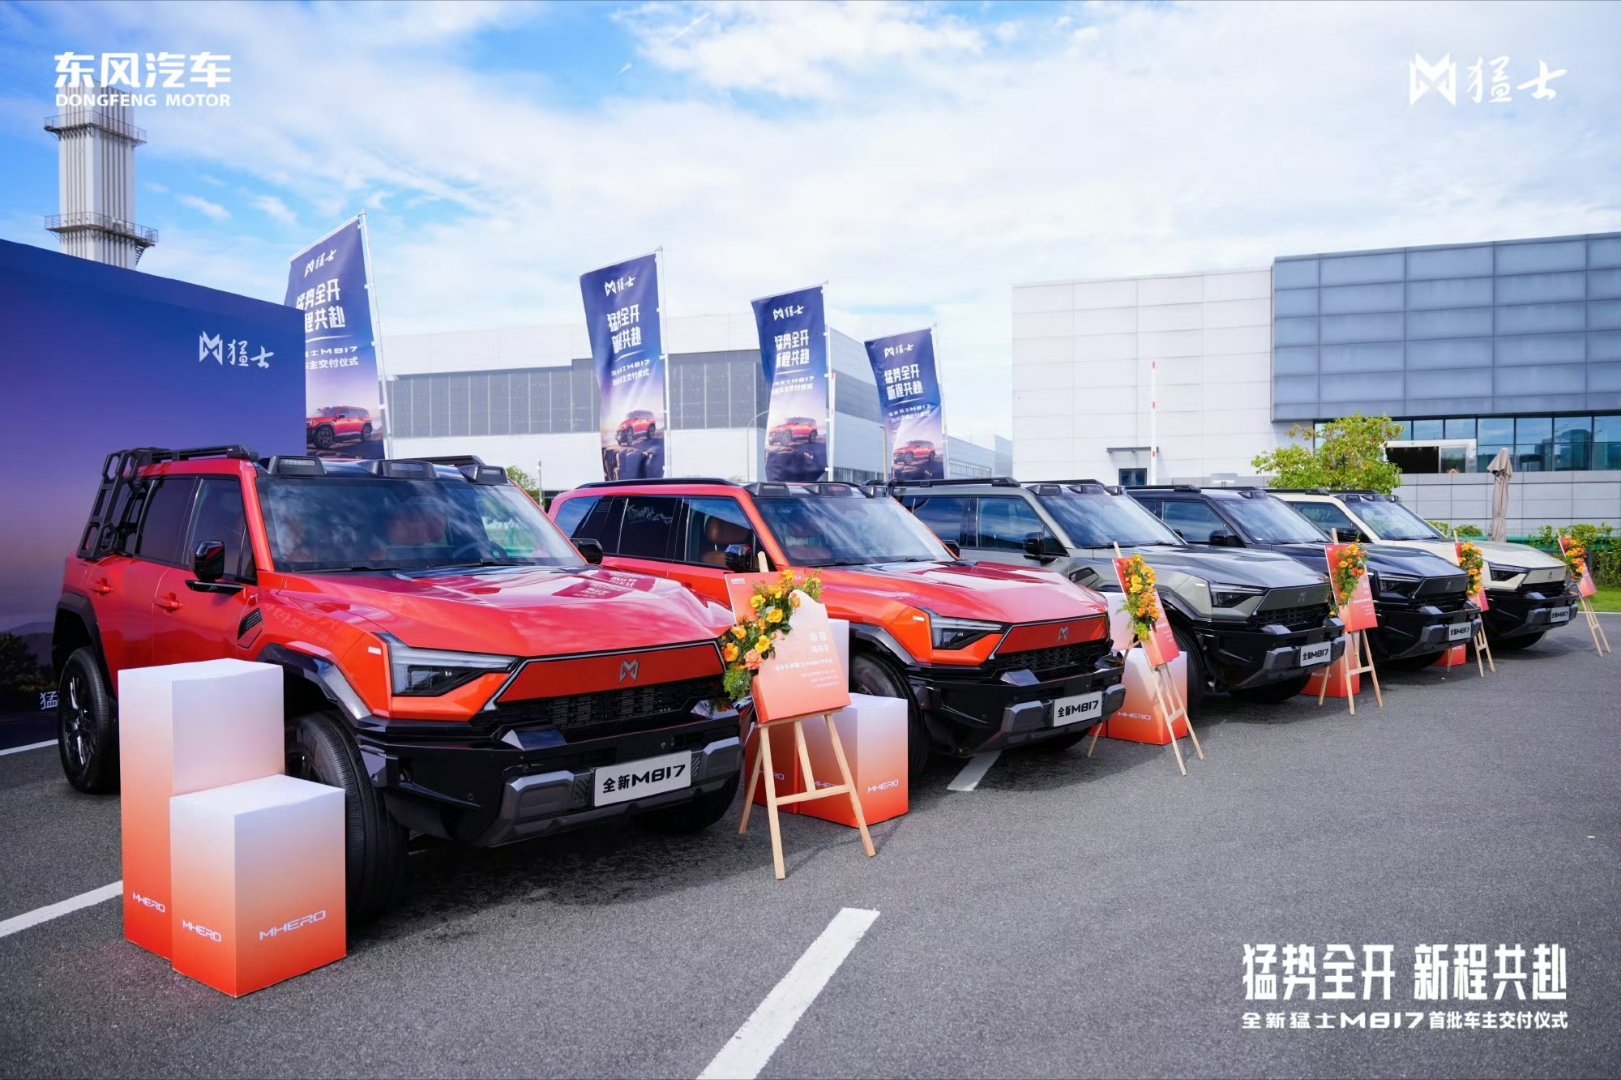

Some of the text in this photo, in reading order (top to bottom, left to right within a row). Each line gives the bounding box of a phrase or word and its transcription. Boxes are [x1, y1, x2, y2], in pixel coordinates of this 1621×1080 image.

[305, 356, 359, 370] 主交付仪式
[40, 690, 59, 710] 猛
[1057, 699, 1099, 718] 全新M817
[603, 764, 686, 794] 全新M817
[867, 779, 899, 793] MHERO
[132, 891, 166, 914] MHERO
[182, 919, 222, 943] MHERO
[259, 909, 327, 941] MHERO
